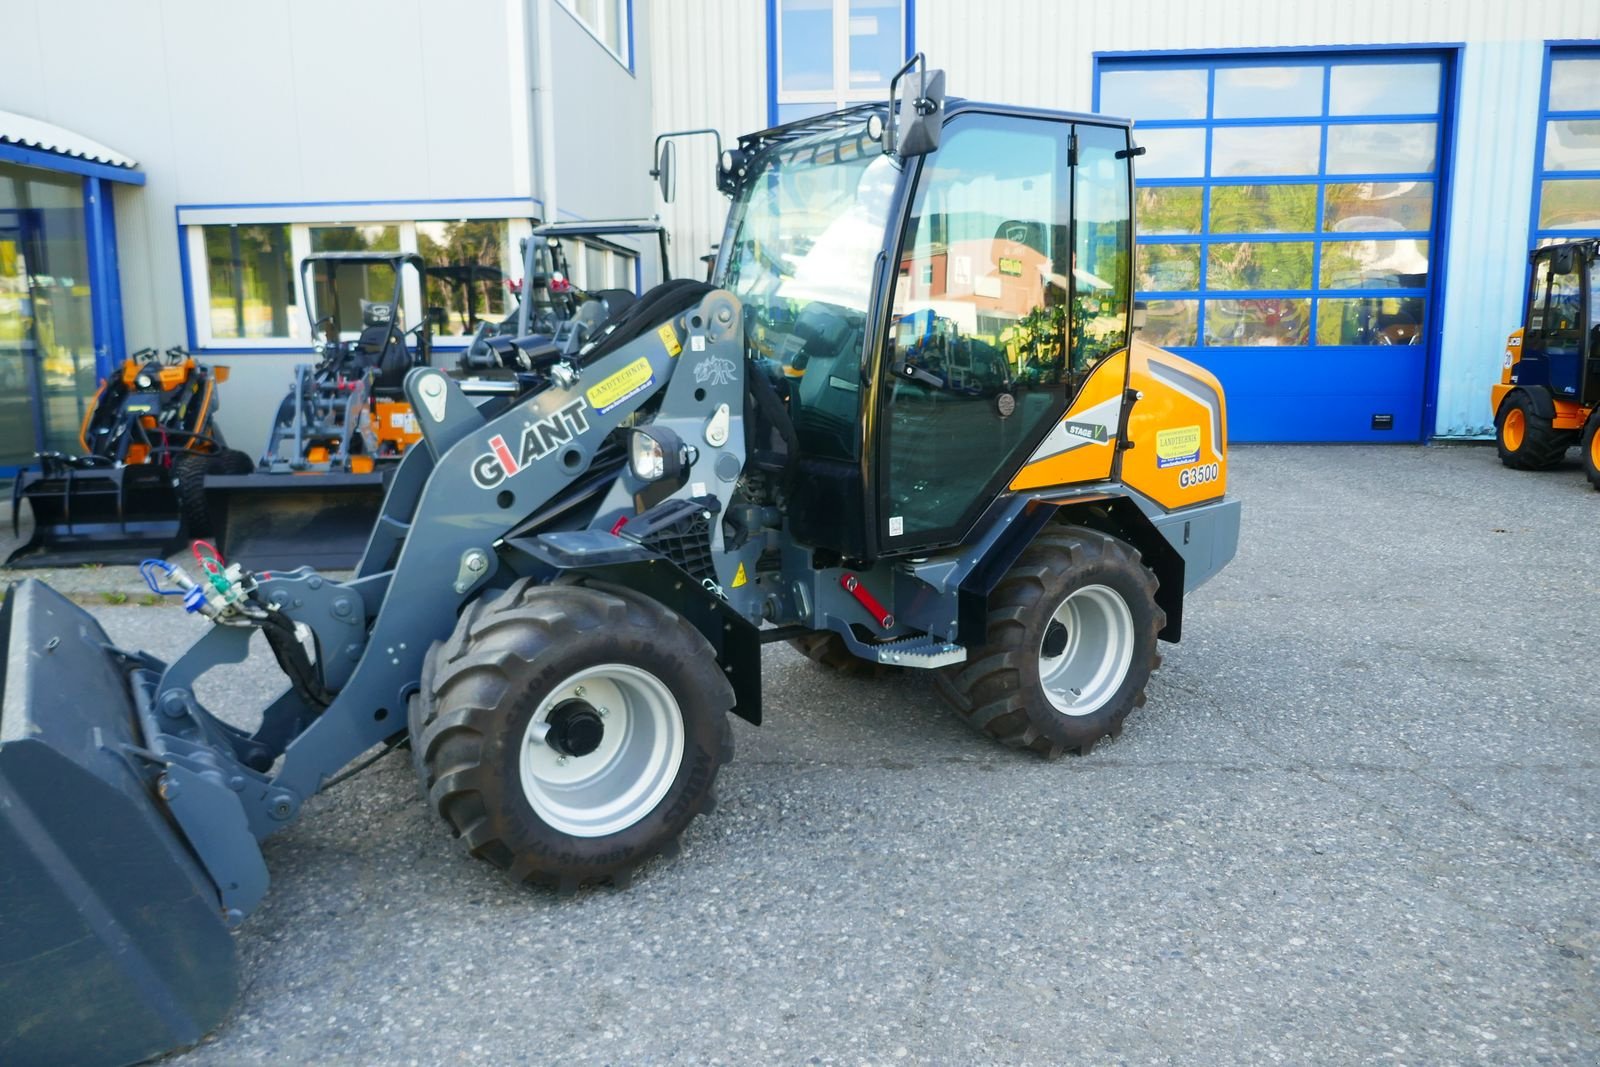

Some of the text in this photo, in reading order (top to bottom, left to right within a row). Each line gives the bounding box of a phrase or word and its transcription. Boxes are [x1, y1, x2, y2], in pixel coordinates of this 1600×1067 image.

[590, 361, 647, 399] LANDTECHNIK
[1069, 425, 1092, 438] STAGE
[1159, 433, 1197, 447] LANDTECHNIK
[1178, 462, 1218, 488] G3500
